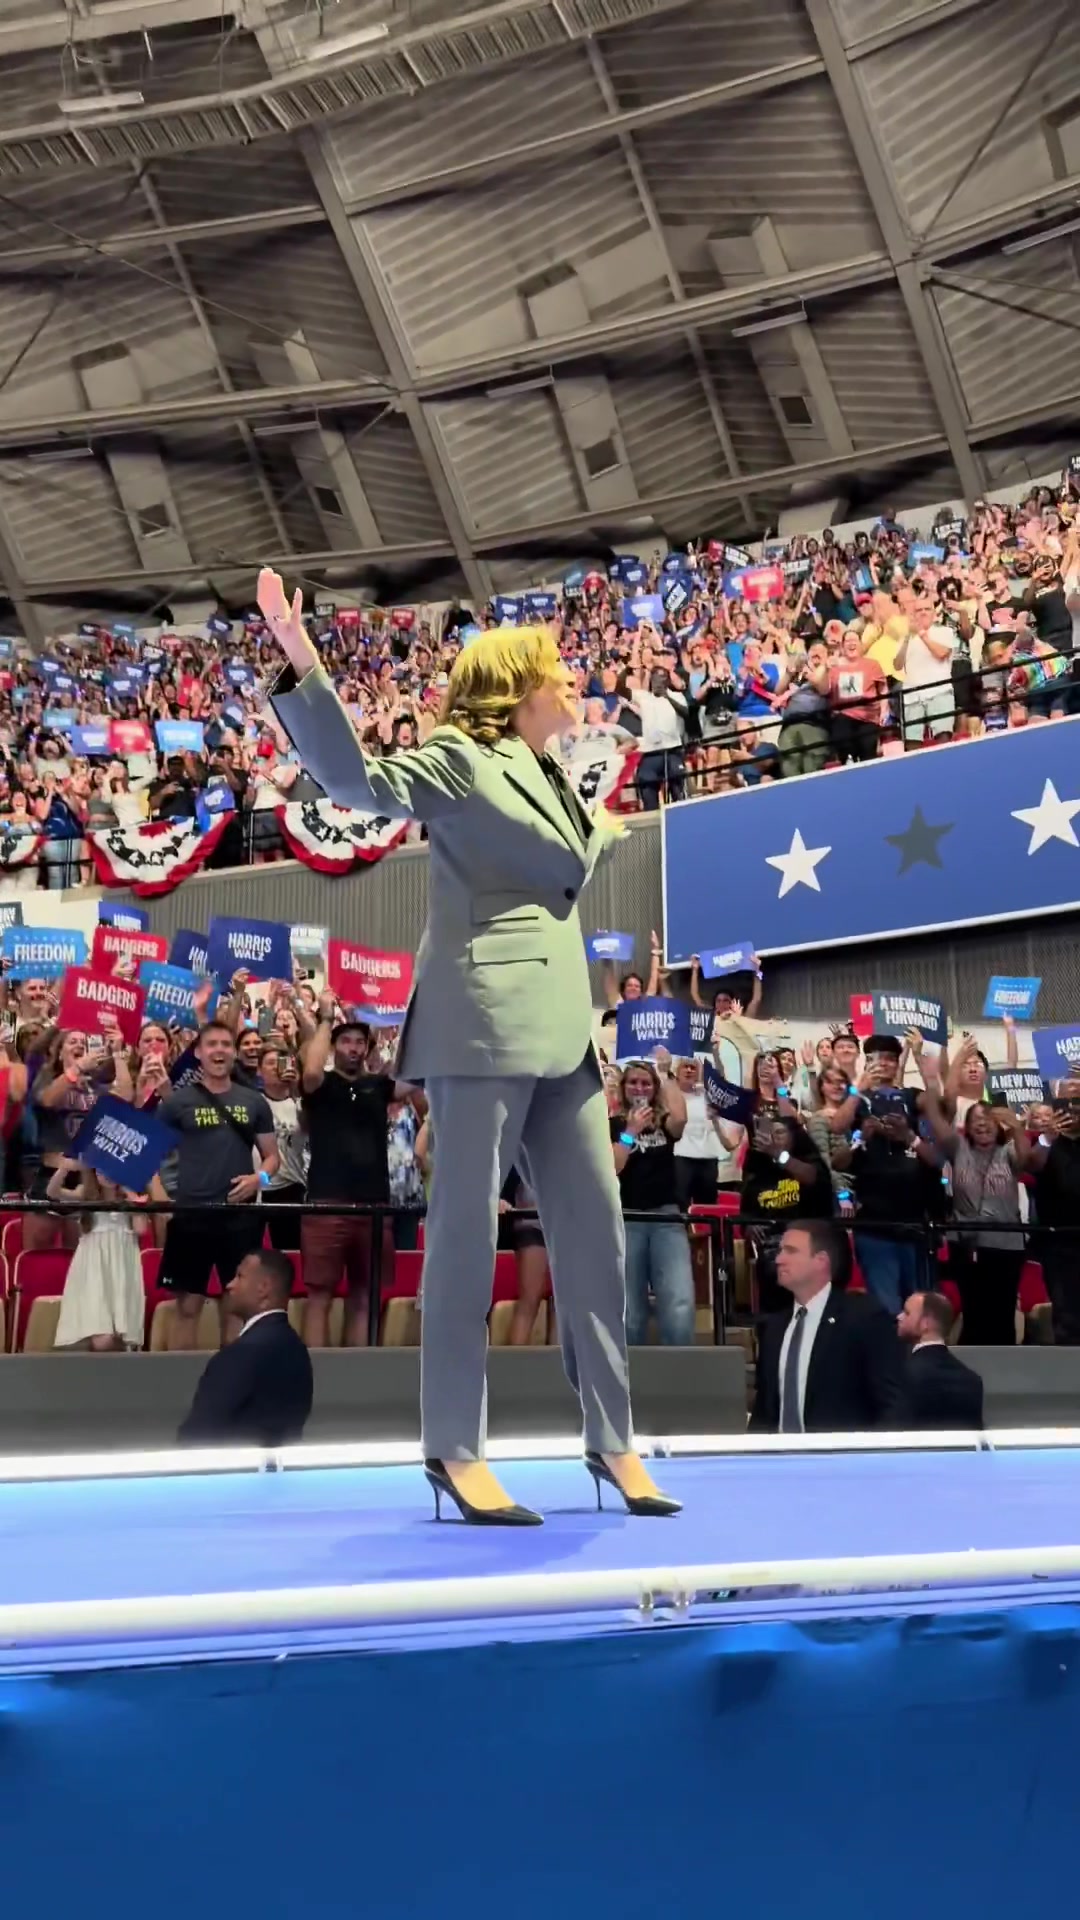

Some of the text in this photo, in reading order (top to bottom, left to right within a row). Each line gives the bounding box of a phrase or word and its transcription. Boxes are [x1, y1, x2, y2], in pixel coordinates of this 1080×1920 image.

[14, 943, 76, 962] FREEDOM
[103, 935, 159, 958] BADGERS
[228, 932, 272, 953] HARRIS
[234, 948, 264, 962] WALZ
[340, 949, 401, 978] BADGERS
[76, 977, 138, 1011] BADGERS
[148, 980, 196, 1009] FREEDO
[880, 995, 889, 1010] A
[890, 996, 916, 1011] NEW
[917, 999, 941, 1018] WAY
[631, 1010, 676, 1031] HARRIS
[885, 1010, 938, 1032] FORWARD
[637, 1028, 669, 1041] WALZ
[991, 1075, 999, 1089] A
[1000, 1074, 1023, 1089] NEW
[195, 1114, 220, 1126] THE
[93, 1135, 131, 1163] WALZ
